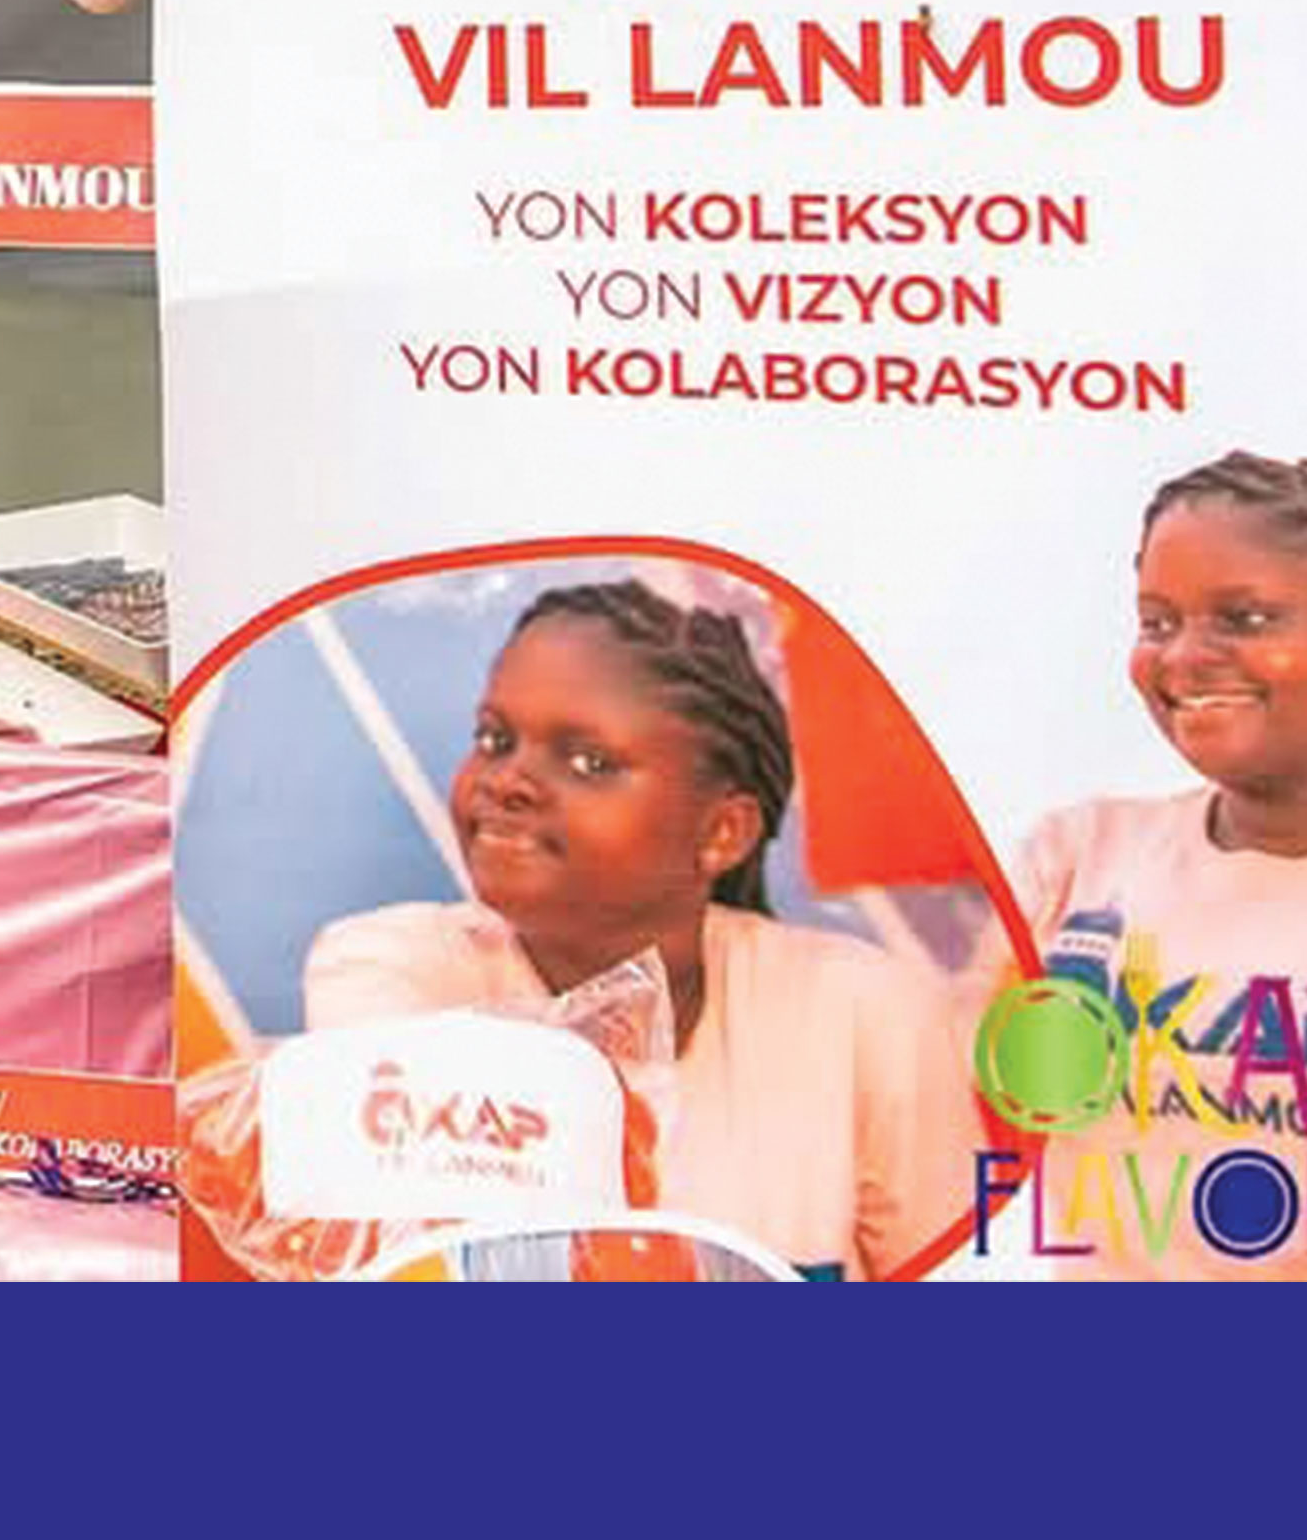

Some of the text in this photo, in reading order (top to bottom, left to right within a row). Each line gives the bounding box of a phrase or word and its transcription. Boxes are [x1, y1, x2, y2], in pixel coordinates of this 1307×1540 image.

[394, 15, 1224, 109] VIL LANMOU
[476, 190, 1087, 245] YON KOLEKSYON
[557, 269, 1001, 326] YON VIZYON
[400, 344, 1186, 414] YON KOLABORASYON
